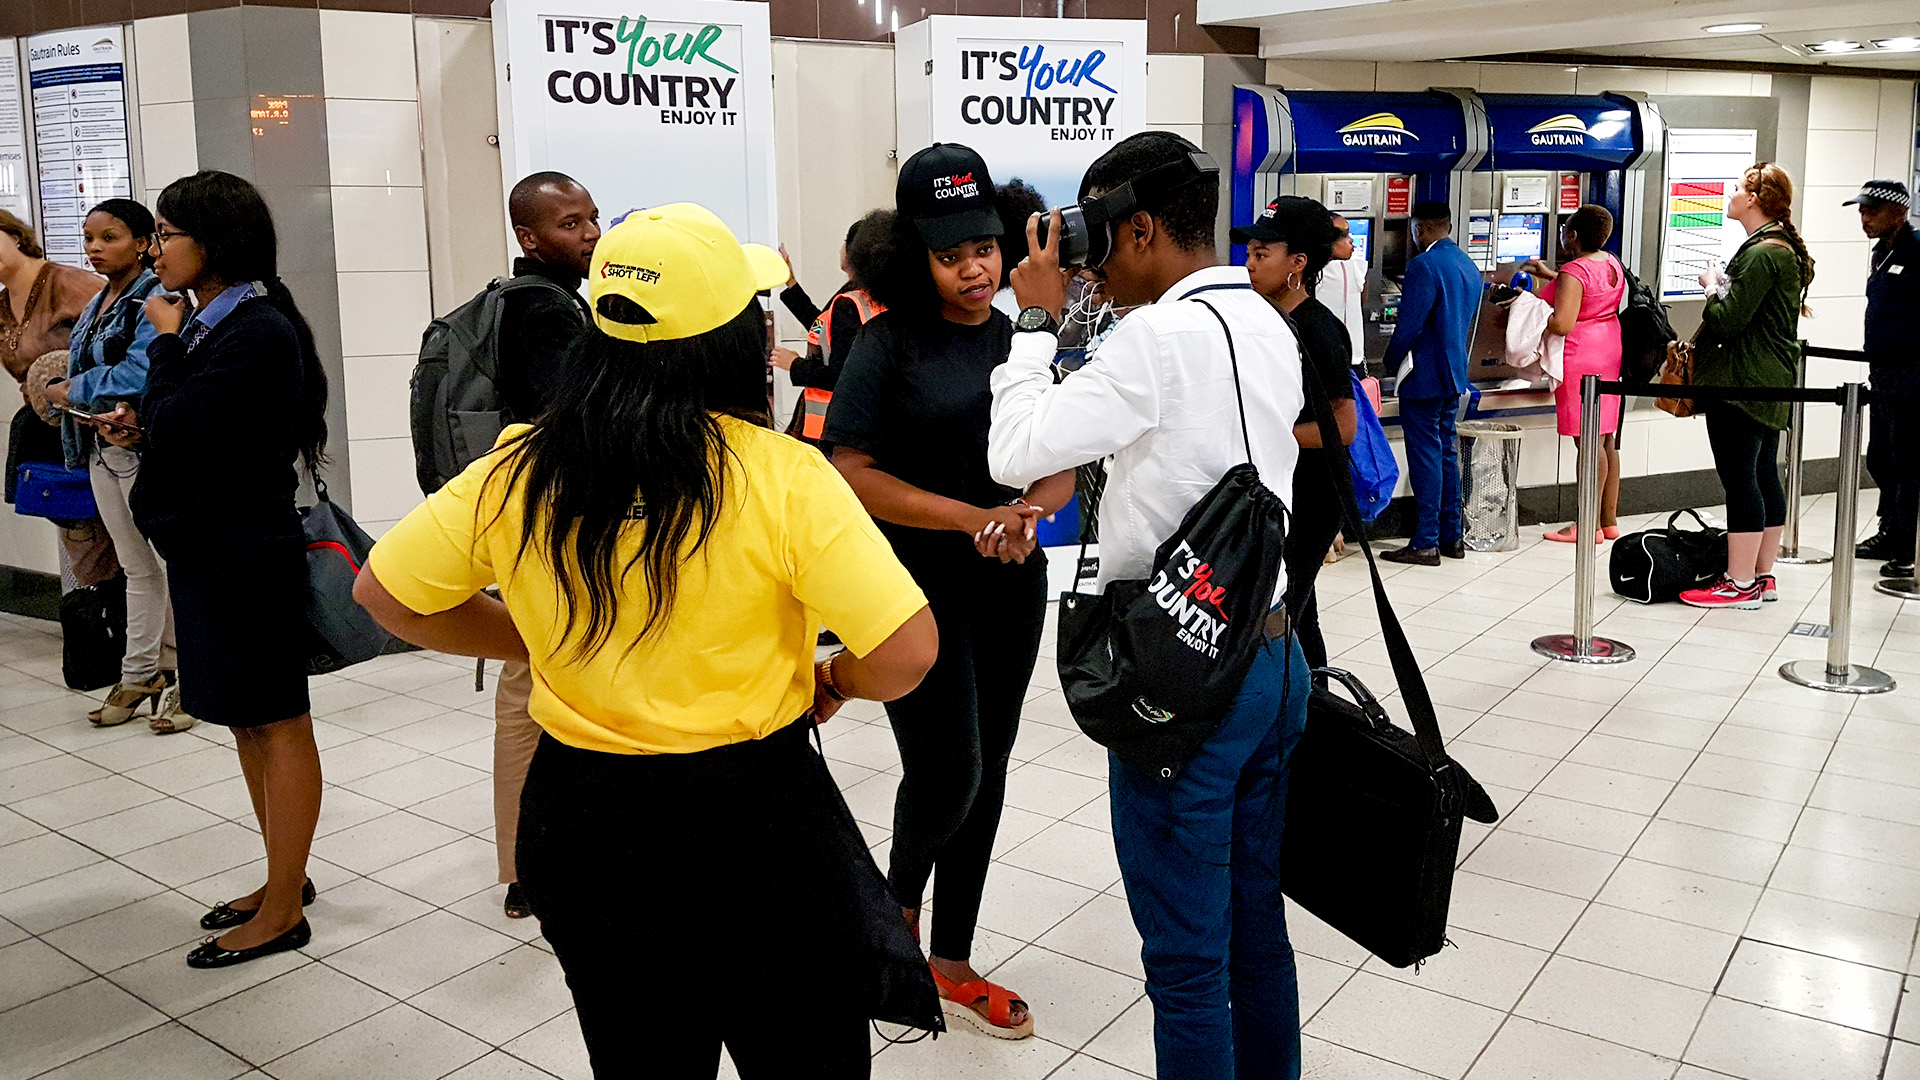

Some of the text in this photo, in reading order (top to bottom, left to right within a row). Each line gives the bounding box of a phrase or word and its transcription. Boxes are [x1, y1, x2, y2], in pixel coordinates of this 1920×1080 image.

[545, 19, 616, 56] IT'S
[30, 43, 81, 61] Gautrain Rules
[961, 50, 1018, 81] IT'S
[547, 70, 736, 109] COUNTRY
[660, 110, 737, 126] ENJOY IT
[961, 95, 1115, 126] COUNTRY
[1051, 128, 1115, 141] ENJOY IT
[1342, 133, 1402, 147] GAUTRAIN
[1530, 133, 1584, 146] GAUTRAIN
[933, 176, 952, 188] IT'S
[935, 182, 977, 199] COUNTRY
[636, 271, 660, 285] LEFT
[1147, 569, 1227, 646] OUNTRY
[1176, 627, 1219, 660] ENJOY IT
